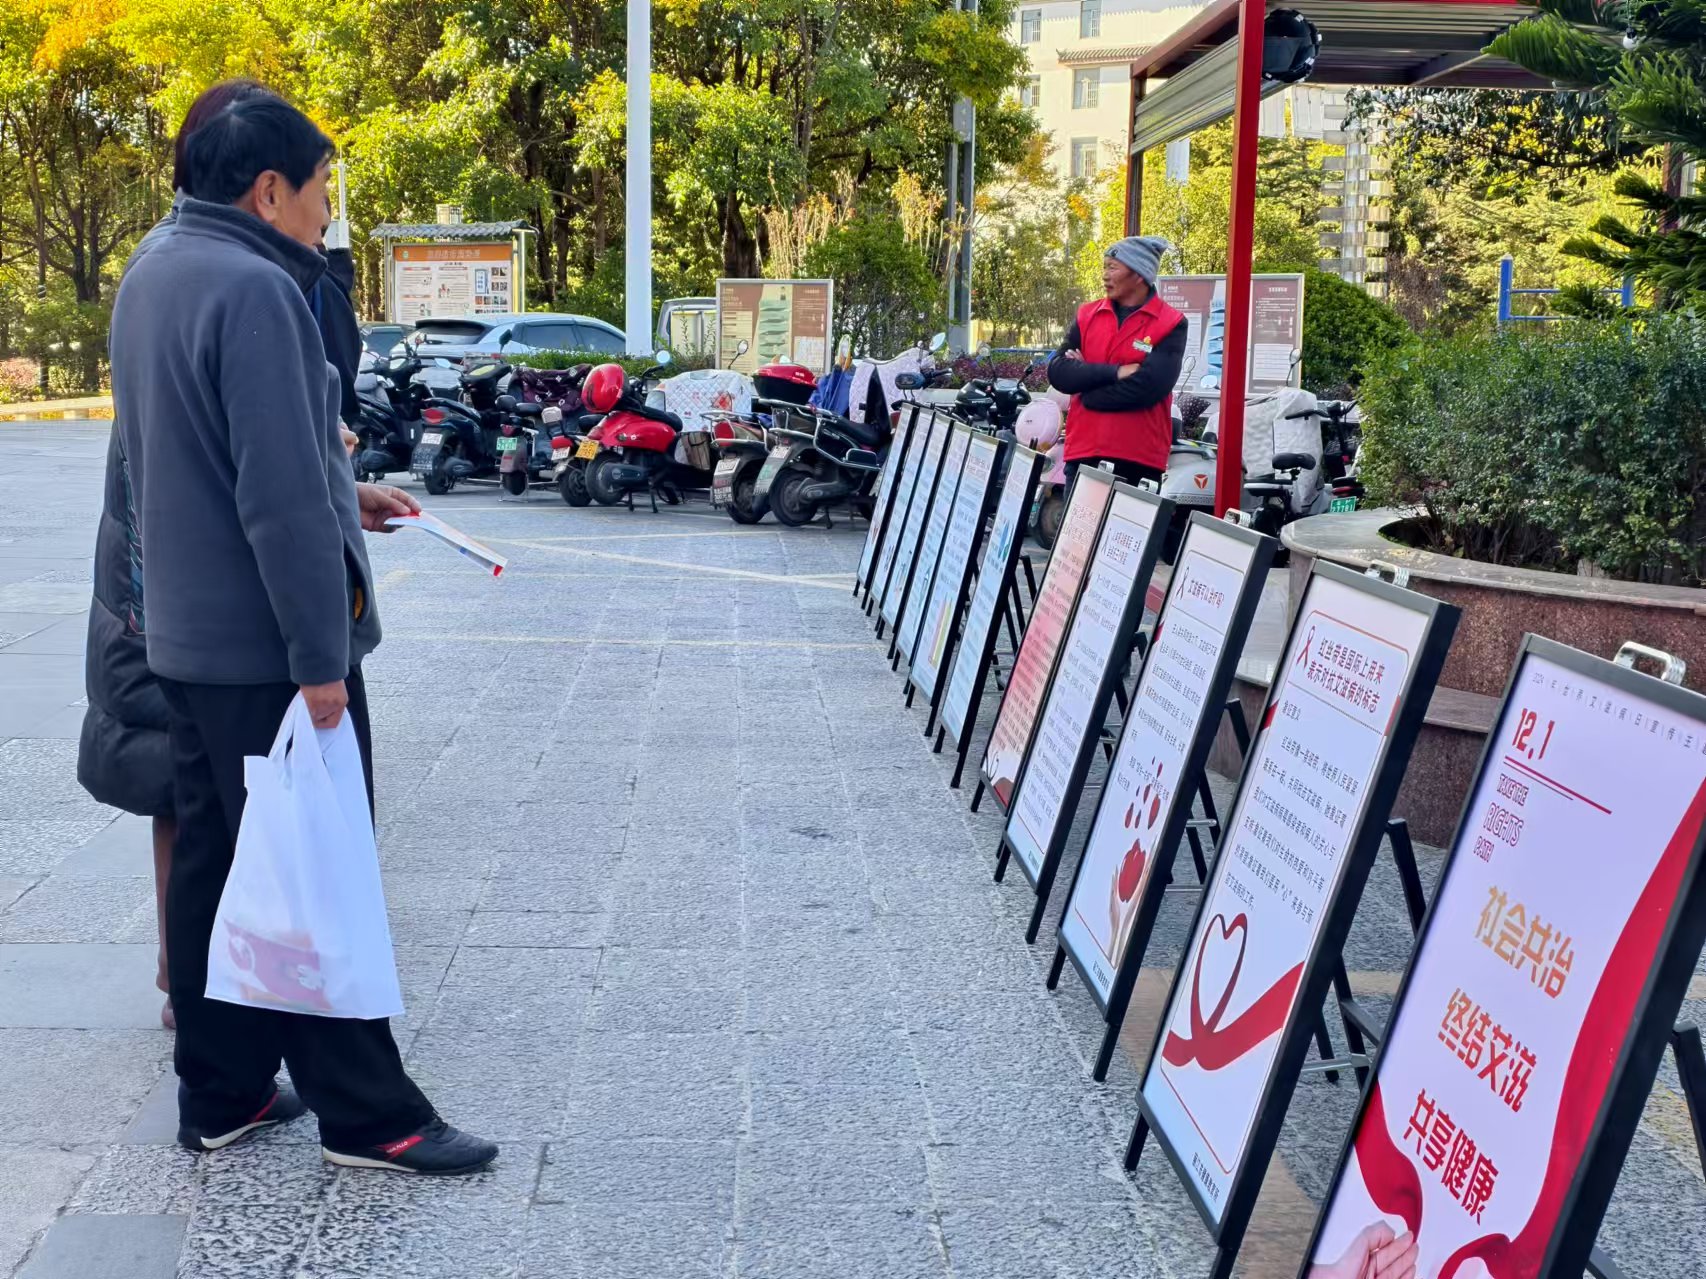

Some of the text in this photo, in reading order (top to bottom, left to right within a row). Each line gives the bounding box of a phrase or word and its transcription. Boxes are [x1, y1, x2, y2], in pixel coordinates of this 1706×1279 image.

[1307, 660, 1381, 714] 表示对抗艾滋病的标志
[1318, 637, 1386, 685] 红丝带是国际上用来
[1512, 707, 1555, 760] 12.1
[1473, 835, 1495, 863] PATH
[1483, 802, 1524, 847] RIGHTS
[1474, 885, 1574, 999] 社会共治
[1437, 987, 1537, 1113] 终结艾滋
[1403, 1088, 1500, 1226] 共享健康
